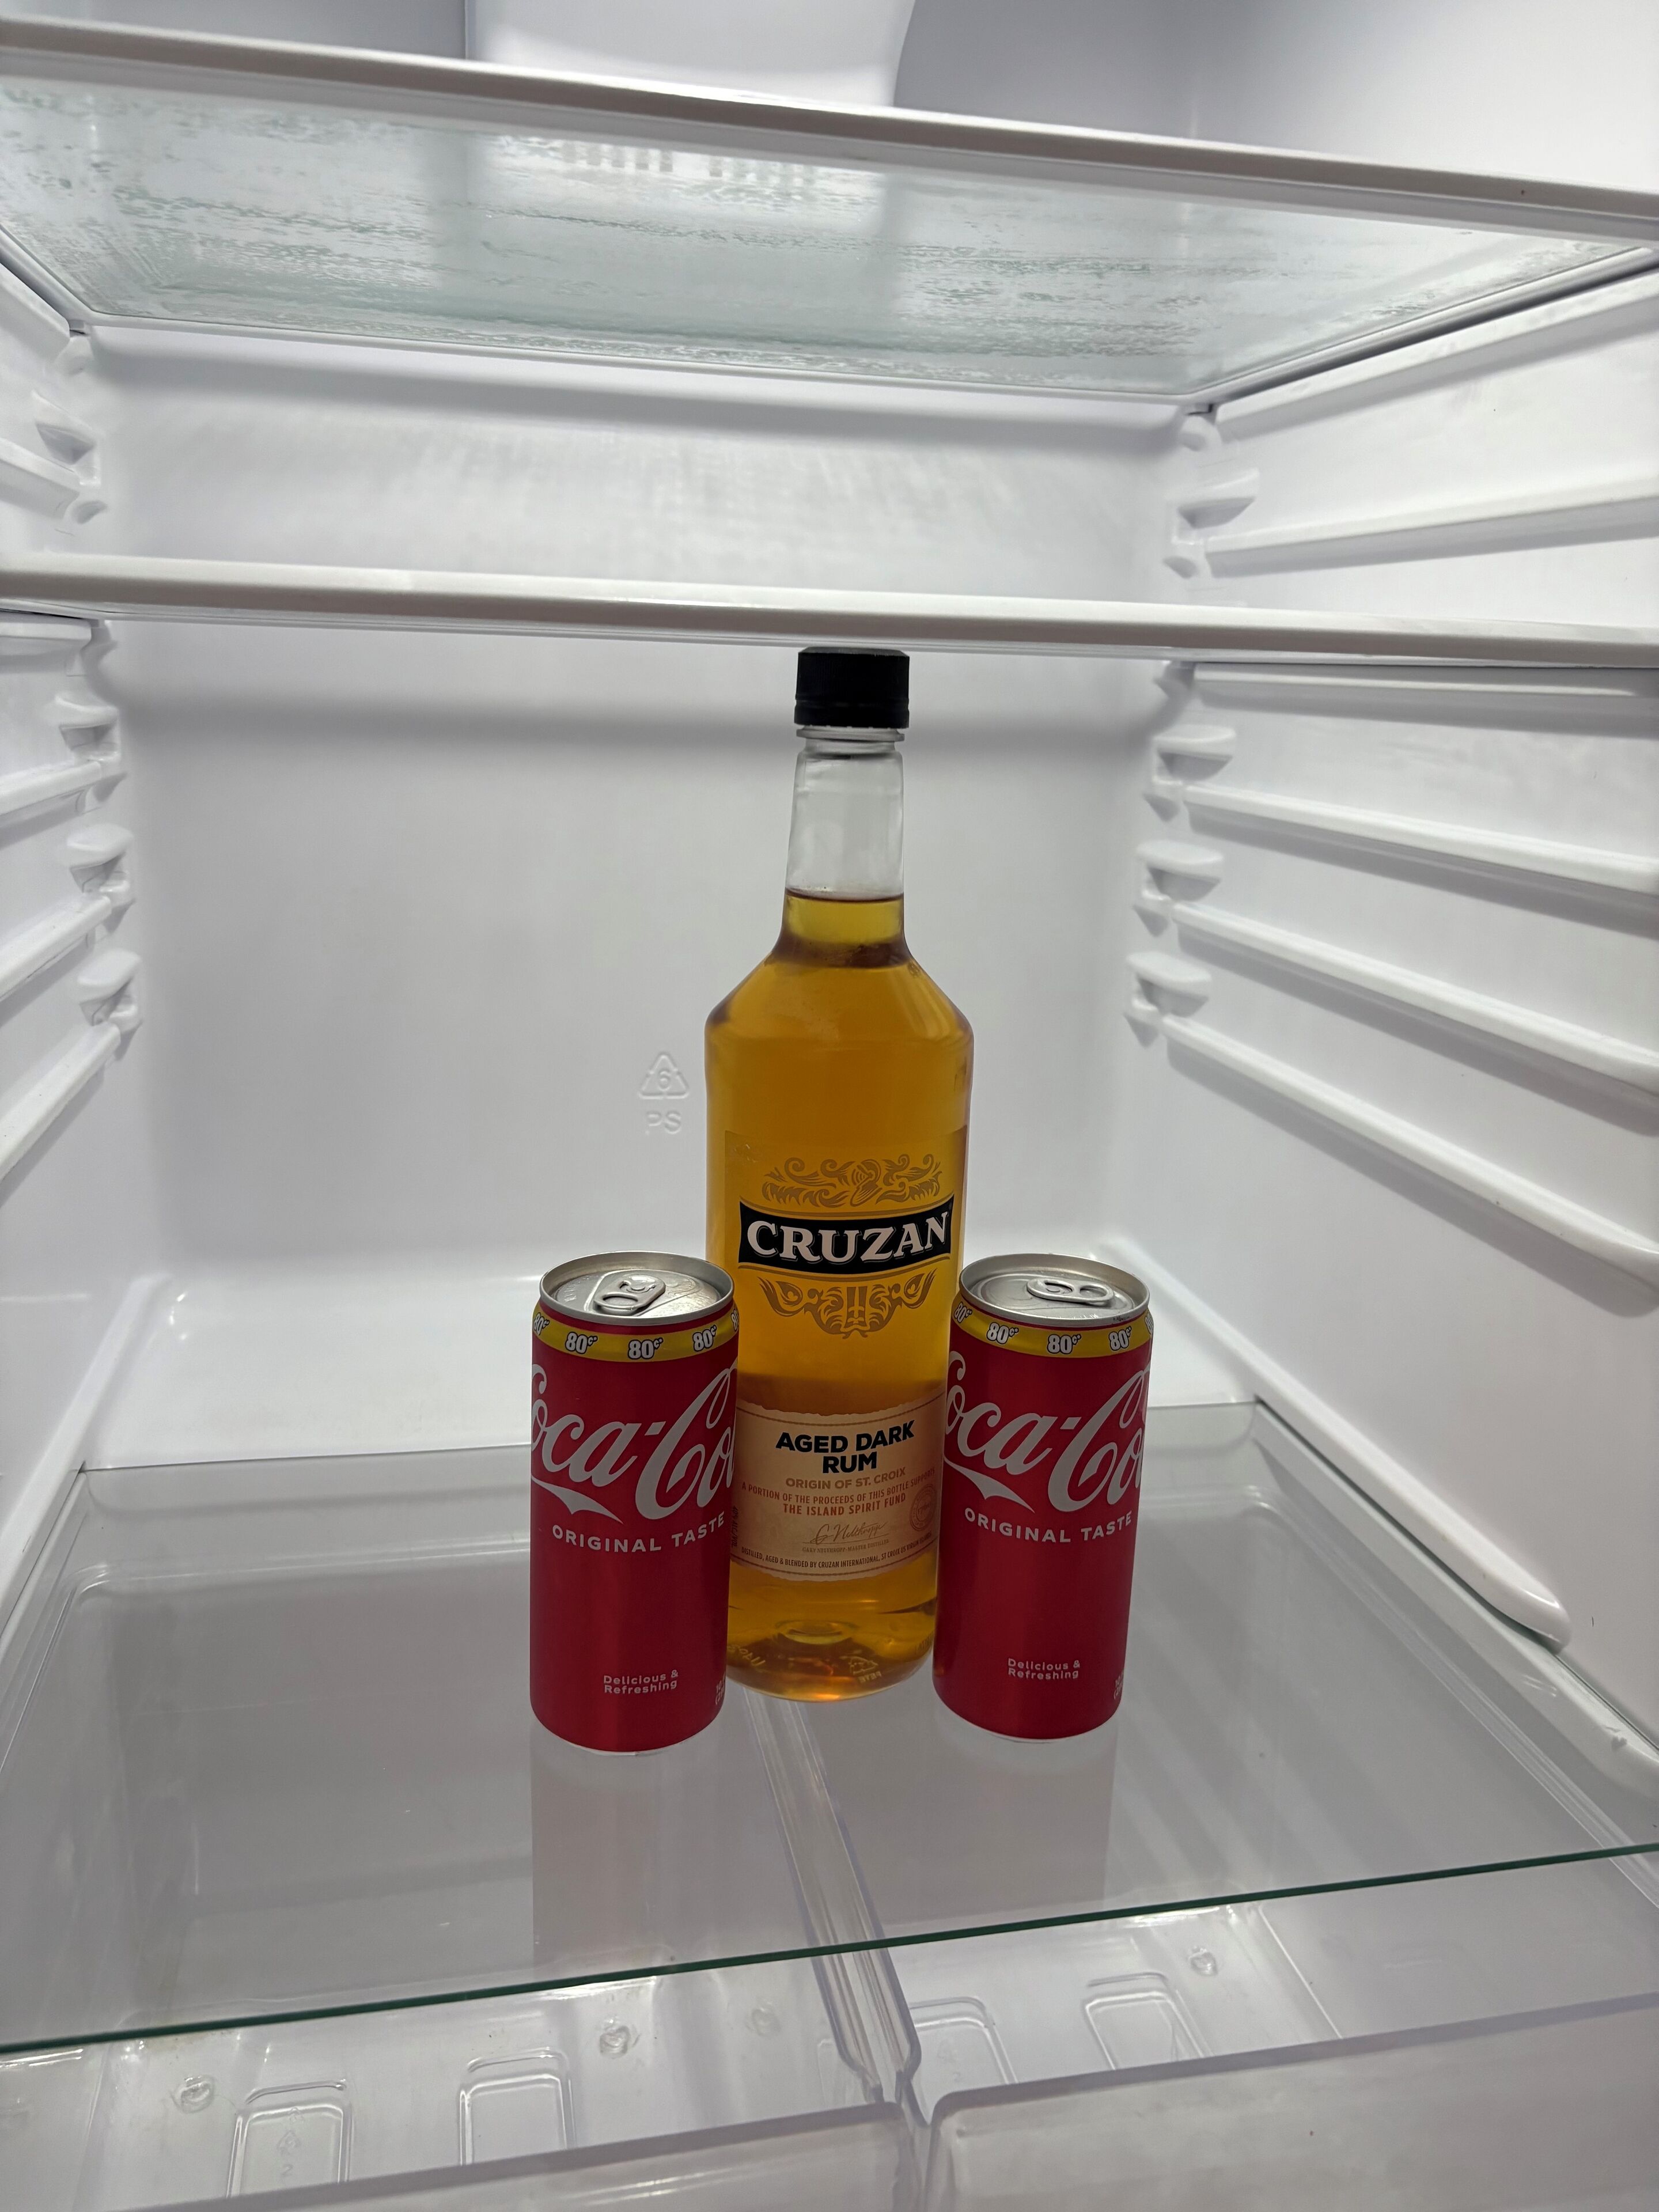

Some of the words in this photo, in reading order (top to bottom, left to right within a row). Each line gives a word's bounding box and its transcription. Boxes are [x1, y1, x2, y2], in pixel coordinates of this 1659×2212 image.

[645, 1110, 681, 1134] PS
[747, 1211, 949, 1263] CRUZAN
[776, 1432, 849, 1453] AGED
[855, 1419, 915, 1452] DARK
[822, 1452, 877, 1474] RUM
[786, 1478, 831, 1489] ORIGIN
[835, 1479, 852, 1489] OF
[855, 1477, 871, 1487] ST.
[874, 1467, 906, 1484] CROIX
[742, 1481, 746, 1490] A
[748, 1484, 779, 1500] PORTION
[782, 1493, 792, 1502] OF
[795, 1495, 810, 1503] THE
[813, 1495, 854, 1504] PROCEEDS
[857, 1493, 866, 1502] OF
[869, 1490, 885, 1500] THIS
[887, 1481, 908, 1495] BOTTLE
[783, 1503, 802, 1514] THE
[807, 1506, 844, 1516] ISLAND
[849, 1500, 881, 1515] SPIRIT
[884, 1493, 906, 1508] FUND
[552, 1524, 662, 1553] ORIGINAL
[671, 1511, 725, 1547] TASTE
[965, 1507, 1071, 1543] ORIGINAL
[1081, 1510, 1132, 1541] TASTE
[741, 1547, 764, 1560] DISTILLED,
[766, 1555, 778, 1563] AGED
[785, 1559, 808, 1567] BLENDED
[1008, 1658, 1069, 1671] Delicious
[1073, 1660, 1080, 1669] &
[1008, 1668, 1079, 1680] Refreshing
[604, 1673, 666, 1685] Delicious
[671, 1669, 679, 1679] &
[605, 1680, 677, 1694] Refreshing
